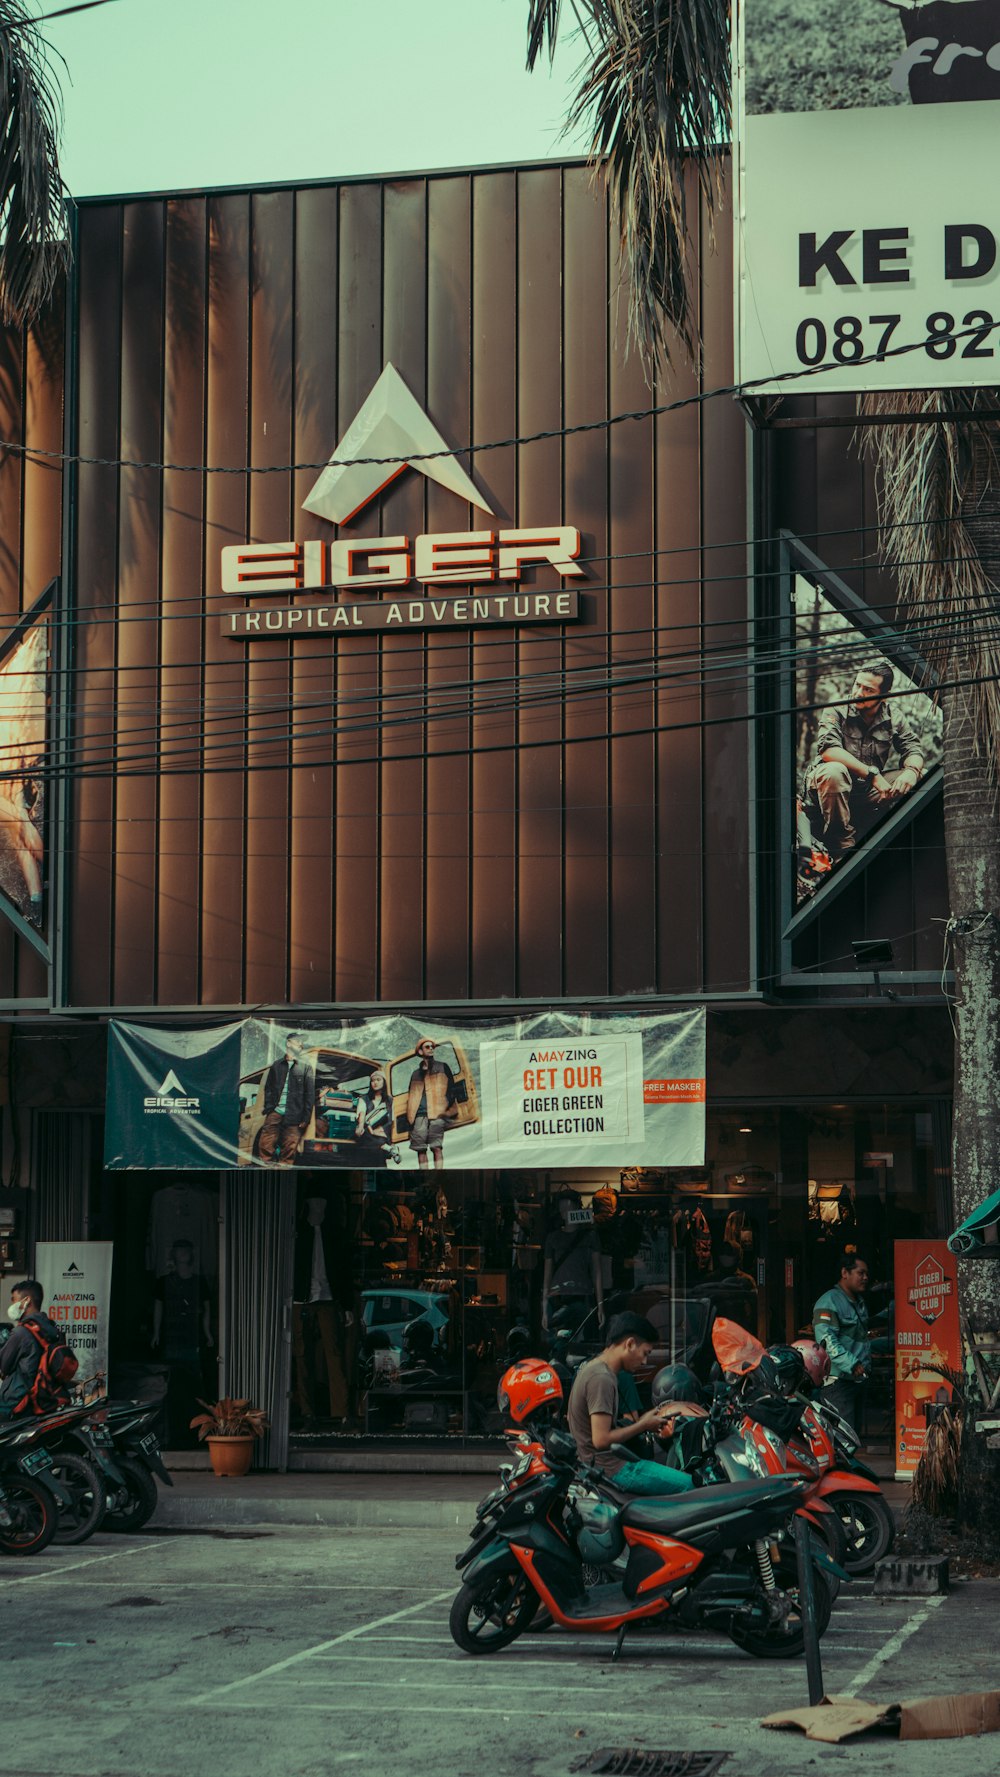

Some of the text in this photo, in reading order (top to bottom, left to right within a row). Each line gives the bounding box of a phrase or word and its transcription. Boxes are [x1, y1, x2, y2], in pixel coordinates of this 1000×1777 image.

[798, 227, 911, 287] KE
[795, 314, 901, 367] 087
[221, 526, 586, 593] EIGER
[228, 594, 571, 631] TROPICAL ADVENTURE
[529, 1049, 597, 1063] AMAYZING
[523, 1066, 602, 1091] GET OUR
[644, 1082, 701, 1091] FREE MASKER
[144, 1097, 200, 1107] EIGER
[523, 1095, 603, 1112] EIGER GREEN
[523, 1117, 604, 1136] COLLECTION
[570, 1211, 591, 1221] BUKA
[919, 1272, 940, 1286] EIGER
[53, 1293, 95, 1301] AMAYZING
[909, 1282, 951, 1300] ADVENTURE
[920, 1297, 939, 1311] CLUB
[48, 1305, 97, 1320] GET OUR
[56, 1324, 97, 1334] GER GREEN
[68, 1338, 97, 1349] ECTION
[898, 1332, 923, 1346] GRATIS
